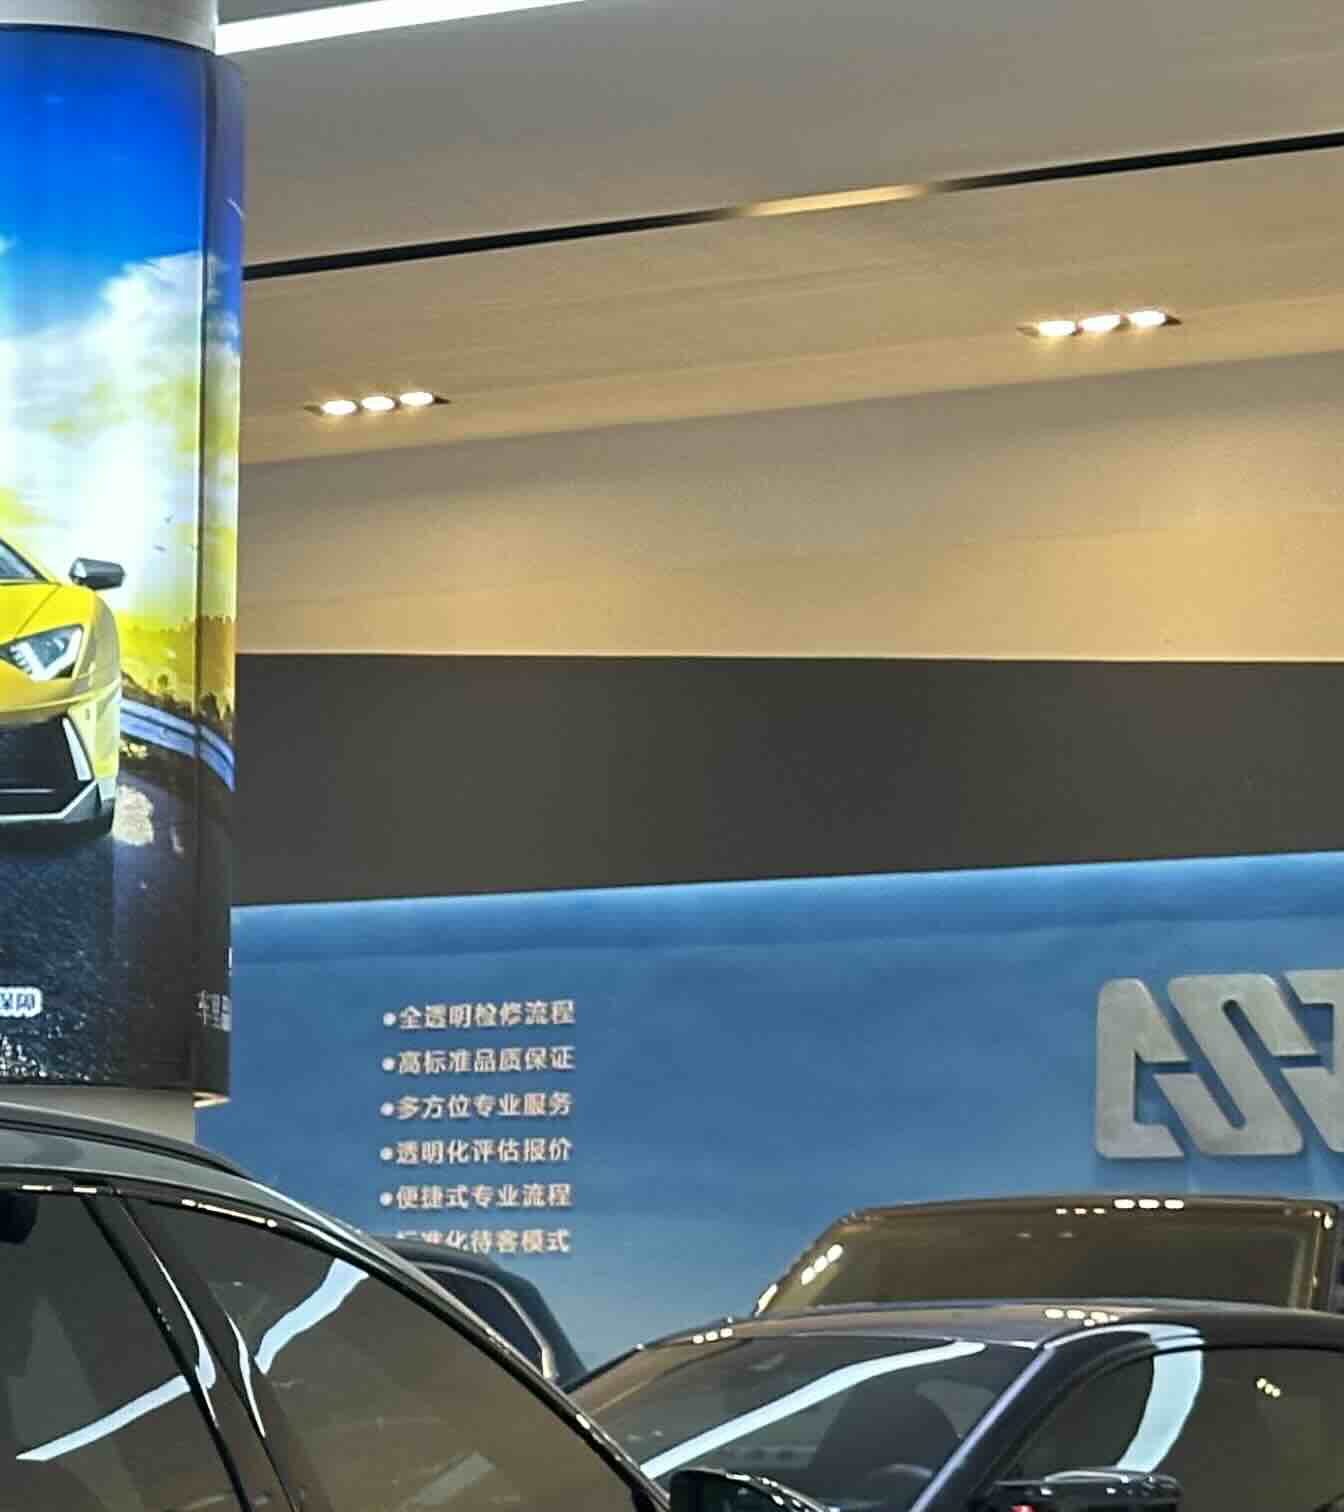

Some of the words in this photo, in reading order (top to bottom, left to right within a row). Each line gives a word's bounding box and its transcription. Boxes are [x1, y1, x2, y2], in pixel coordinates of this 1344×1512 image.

[397, 1046, 575, 1074] 高标准品质保证
[396, 1092, 573, 1119] 多方位专业服务
[395, 1138, 573, 1164] 透明化评估报价
[395, 1183, 573, 1209] 便捷式专业流程
